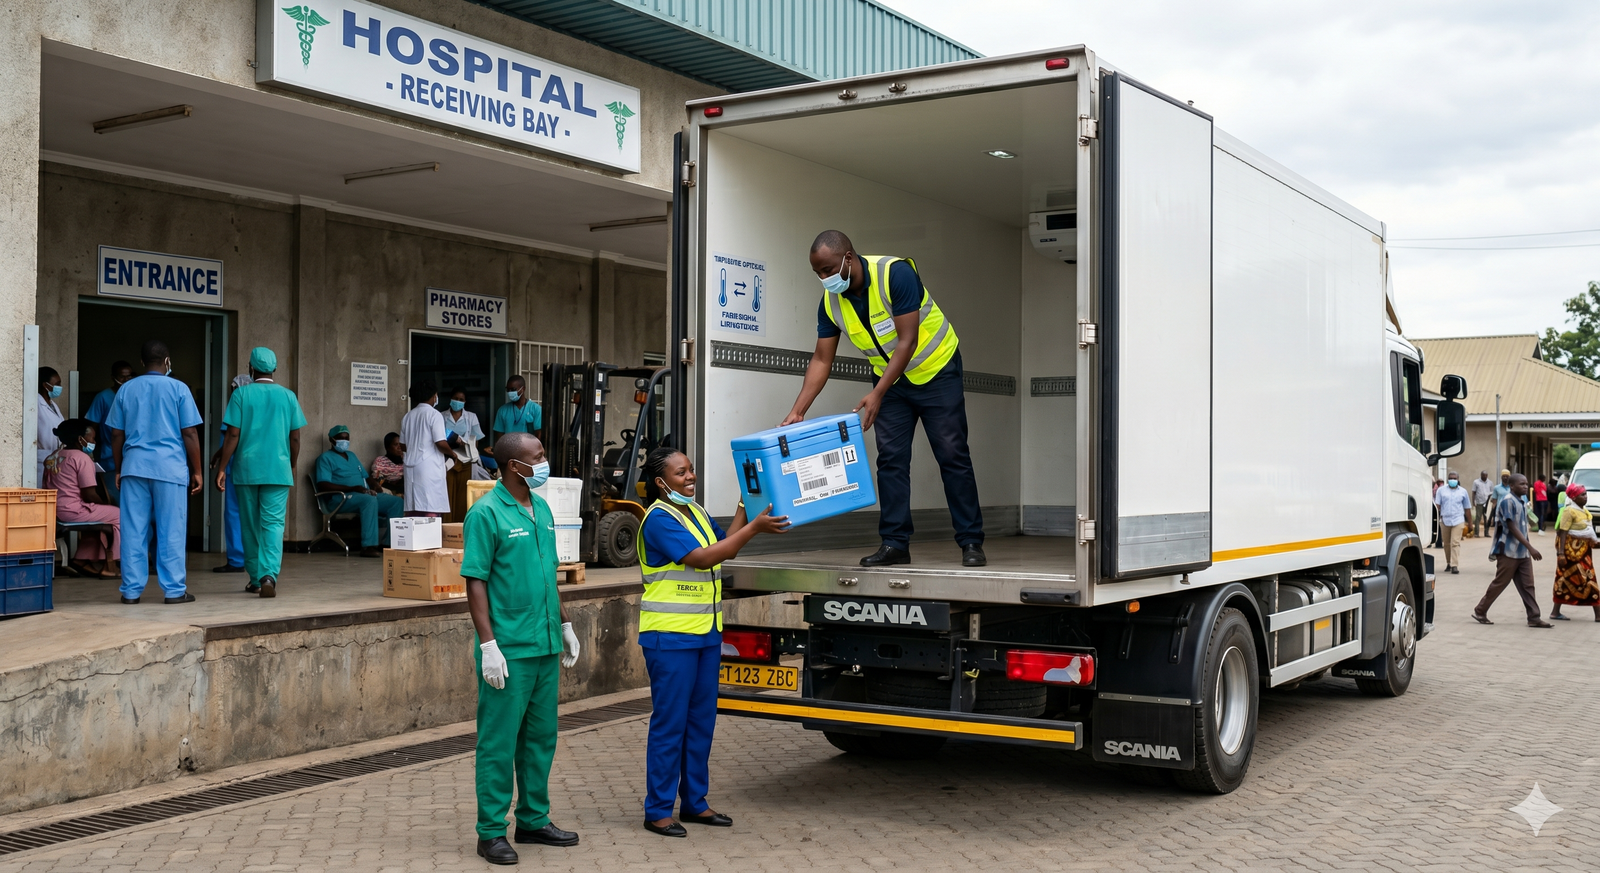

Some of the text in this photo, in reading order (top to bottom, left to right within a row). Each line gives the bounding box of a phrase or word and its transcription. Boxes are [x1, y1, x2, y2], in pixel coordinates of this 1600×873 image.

[343, 9, 597, 118] HOSPITAL
[401, 73, 515, 127] RECEIVING
[523, 107, 559, 138] BAY
[104, 257, 218, 295] ENTRANCE
[430, 293, 503, 313] PHARMACY
[442, 311, 492, 328] STORES
[823, 600, 928, 626] SCANIA
[766, 668, 793, 687] ZBC
[1341, 669, 1375, 677] SCANIA
[1104, 740, 1181, 761] SCANIA
